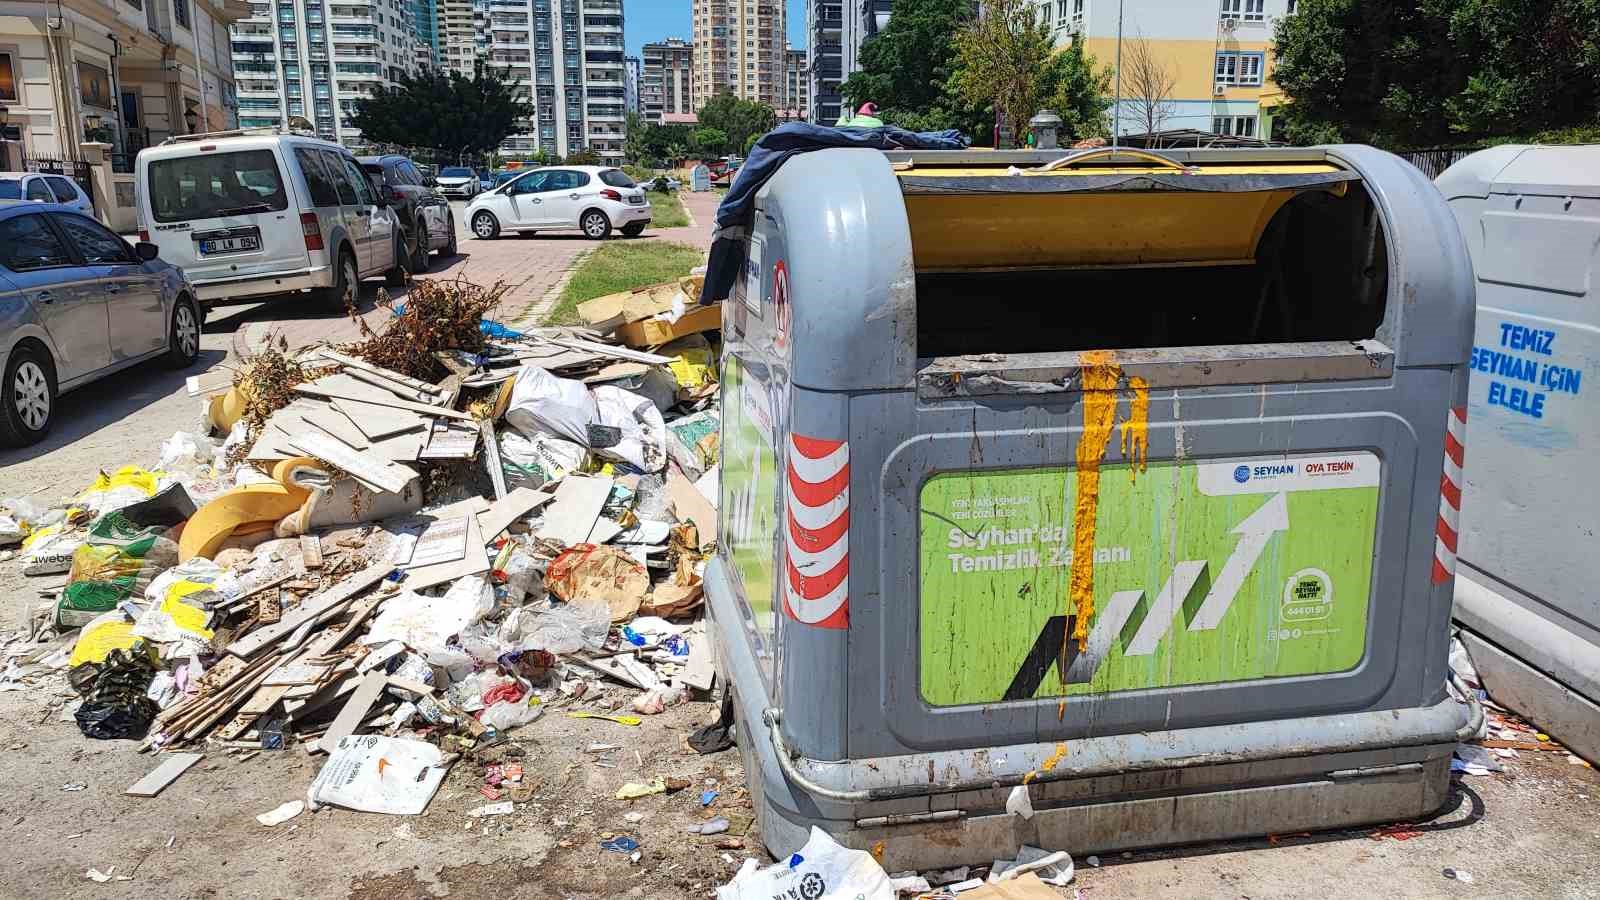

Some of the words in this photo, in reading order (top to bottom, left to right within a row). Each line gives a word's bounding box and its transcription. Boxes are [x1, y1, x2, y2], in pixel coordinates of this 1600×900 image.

[1488, 381, 1545, 418] ELELE
[1254, 464, 1294, 476] SEYHAN
[1305, 463, 1325, 473] OYA
[38, 551, 73, 563] webe
[947, 548, 1040, 574] Temizlik
[1047, 546, 1131, 568] Zaanı
